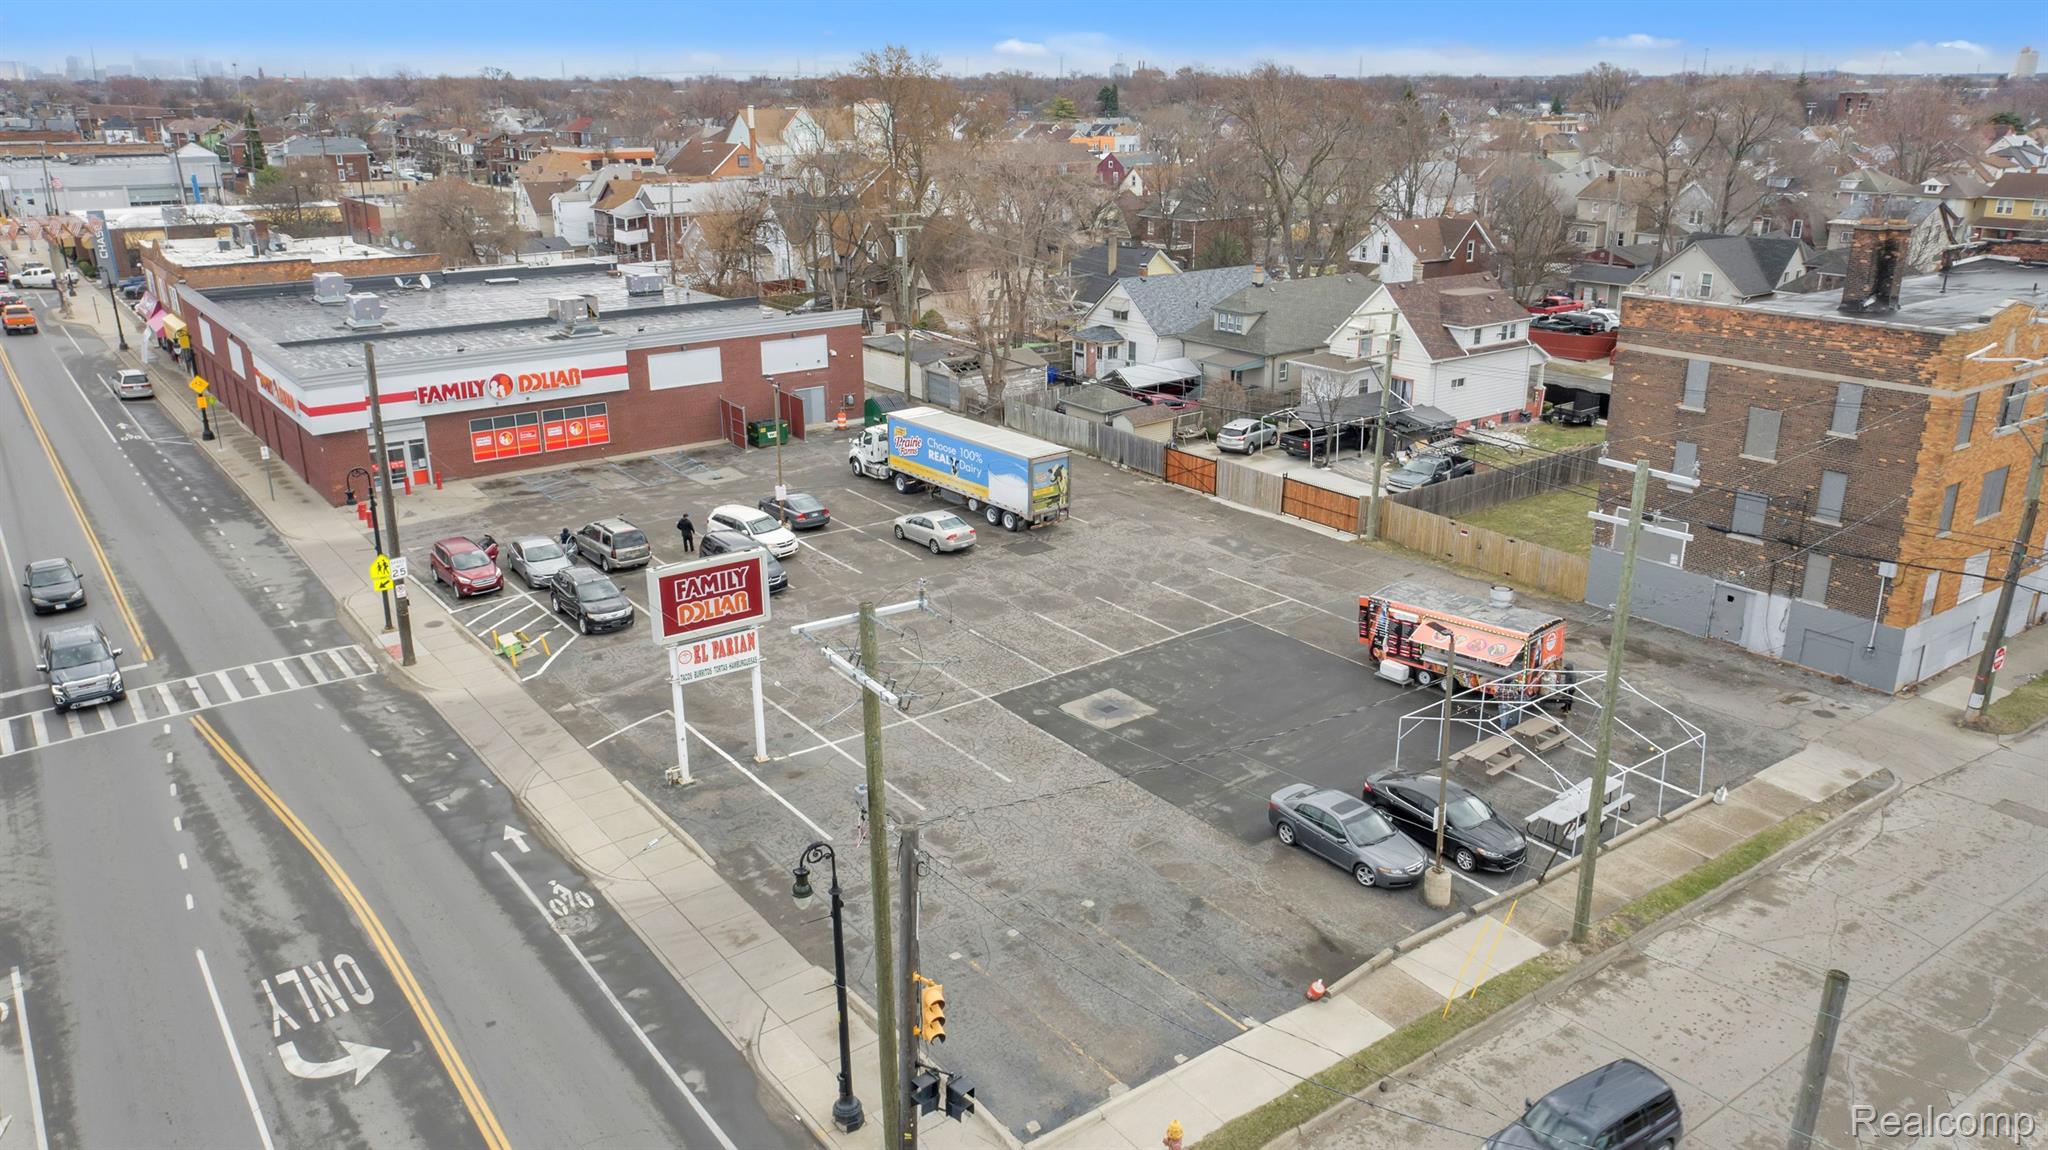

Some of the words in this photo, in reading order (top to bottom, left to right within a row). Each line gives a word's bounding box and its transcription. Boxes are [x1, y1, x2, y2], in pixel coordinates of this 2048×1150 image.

[96, 224, 109, 259] CHAS
[417, 379, 486, 405] FAMILY
[518, 367, 581, 393] DOLLAR
[895, 435, 922, 449] Prairie
[927, 437, 957, 455] Choose
[960, 447, 983, 464] 100%
[928, 449, 952, 466] REAL
[959, 460, 983, 478] Dairy
[392, 568, 406, 577] 25
[674, 566, 749, 602] FAMILY
[677, 590, 750, 626] DOLLAR
[693, 643, 709, 664] EL
[712, 631, 755, 660] PARIAN
[261, 953, 375, 1037] ONLY
